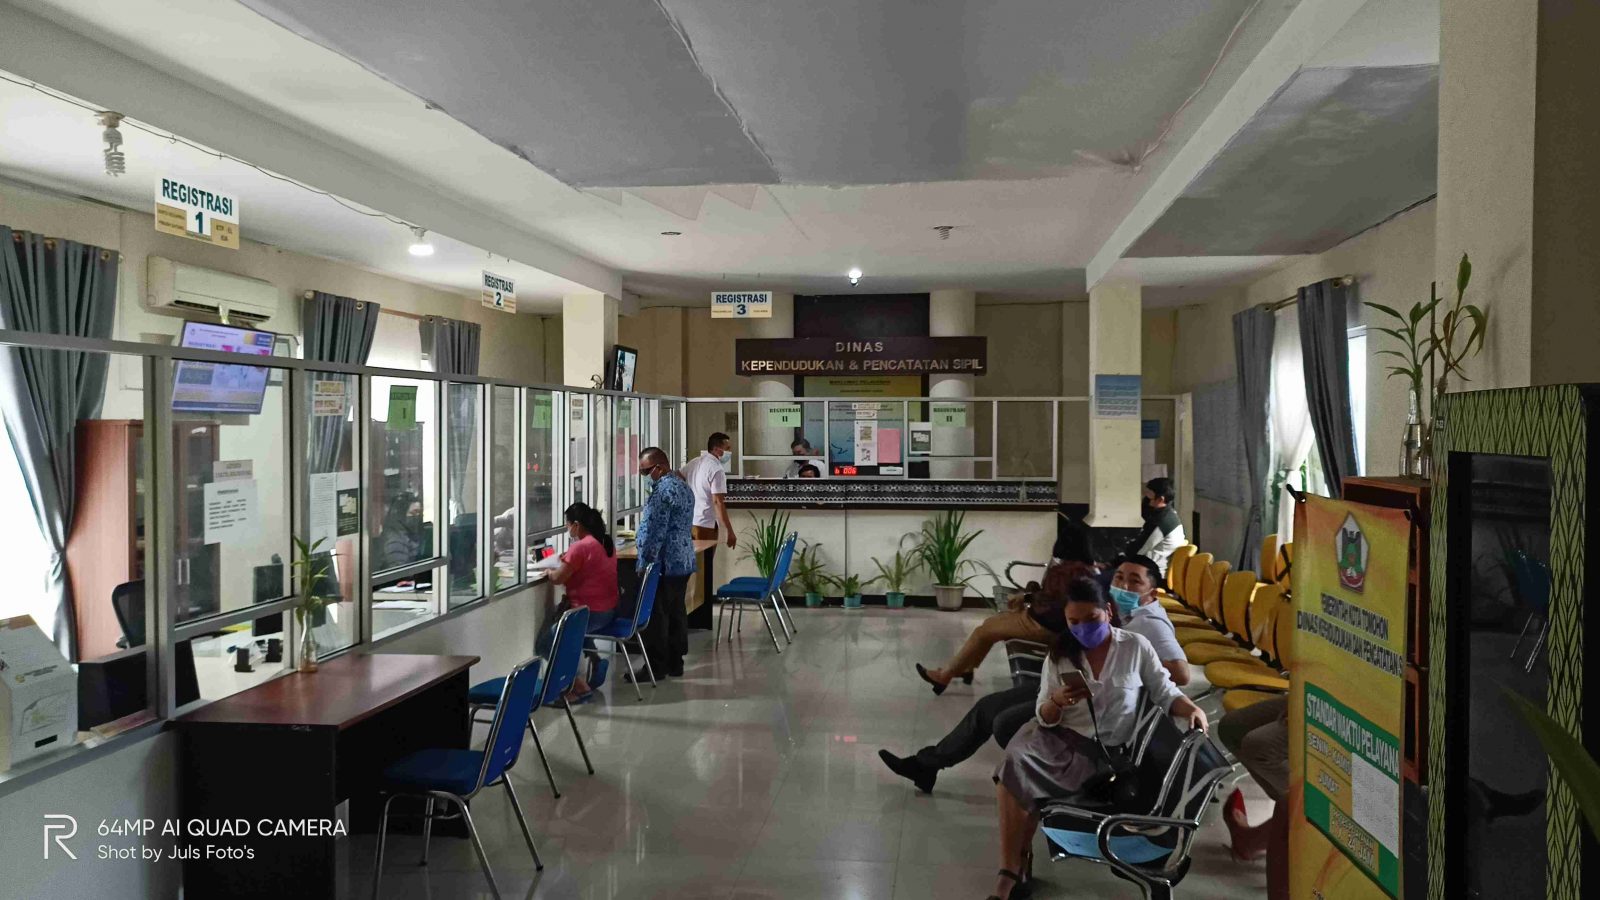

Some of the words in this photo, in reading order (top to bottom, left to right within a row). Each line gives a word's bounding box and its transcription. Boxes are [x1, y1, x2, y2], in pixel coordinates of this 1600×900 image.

[162, 178, 233, 216] REGISTRASI
[195, 211, 203, 234] 1
[484, 274, 514, 294] REGISTRASI
[495, 291, 502, 306] 2
[716, 294, 767, 303] REGISTRASI
[736, 303, 747, 315] 3
[835, 342, 884, 352] DINAS
[741, 360, 844, 371] KEPENDUDUKAN
[848, 361, 859, 370] &
[863, 359, 949, 371] PENCATATAN
[952, 358, 983, 370] SIPIL
[1297, 610, 1318, 635] DINAS
[1307, 692, 1337, 735] STANDAR
[1337, 711, 1360, 752] WAKTU
